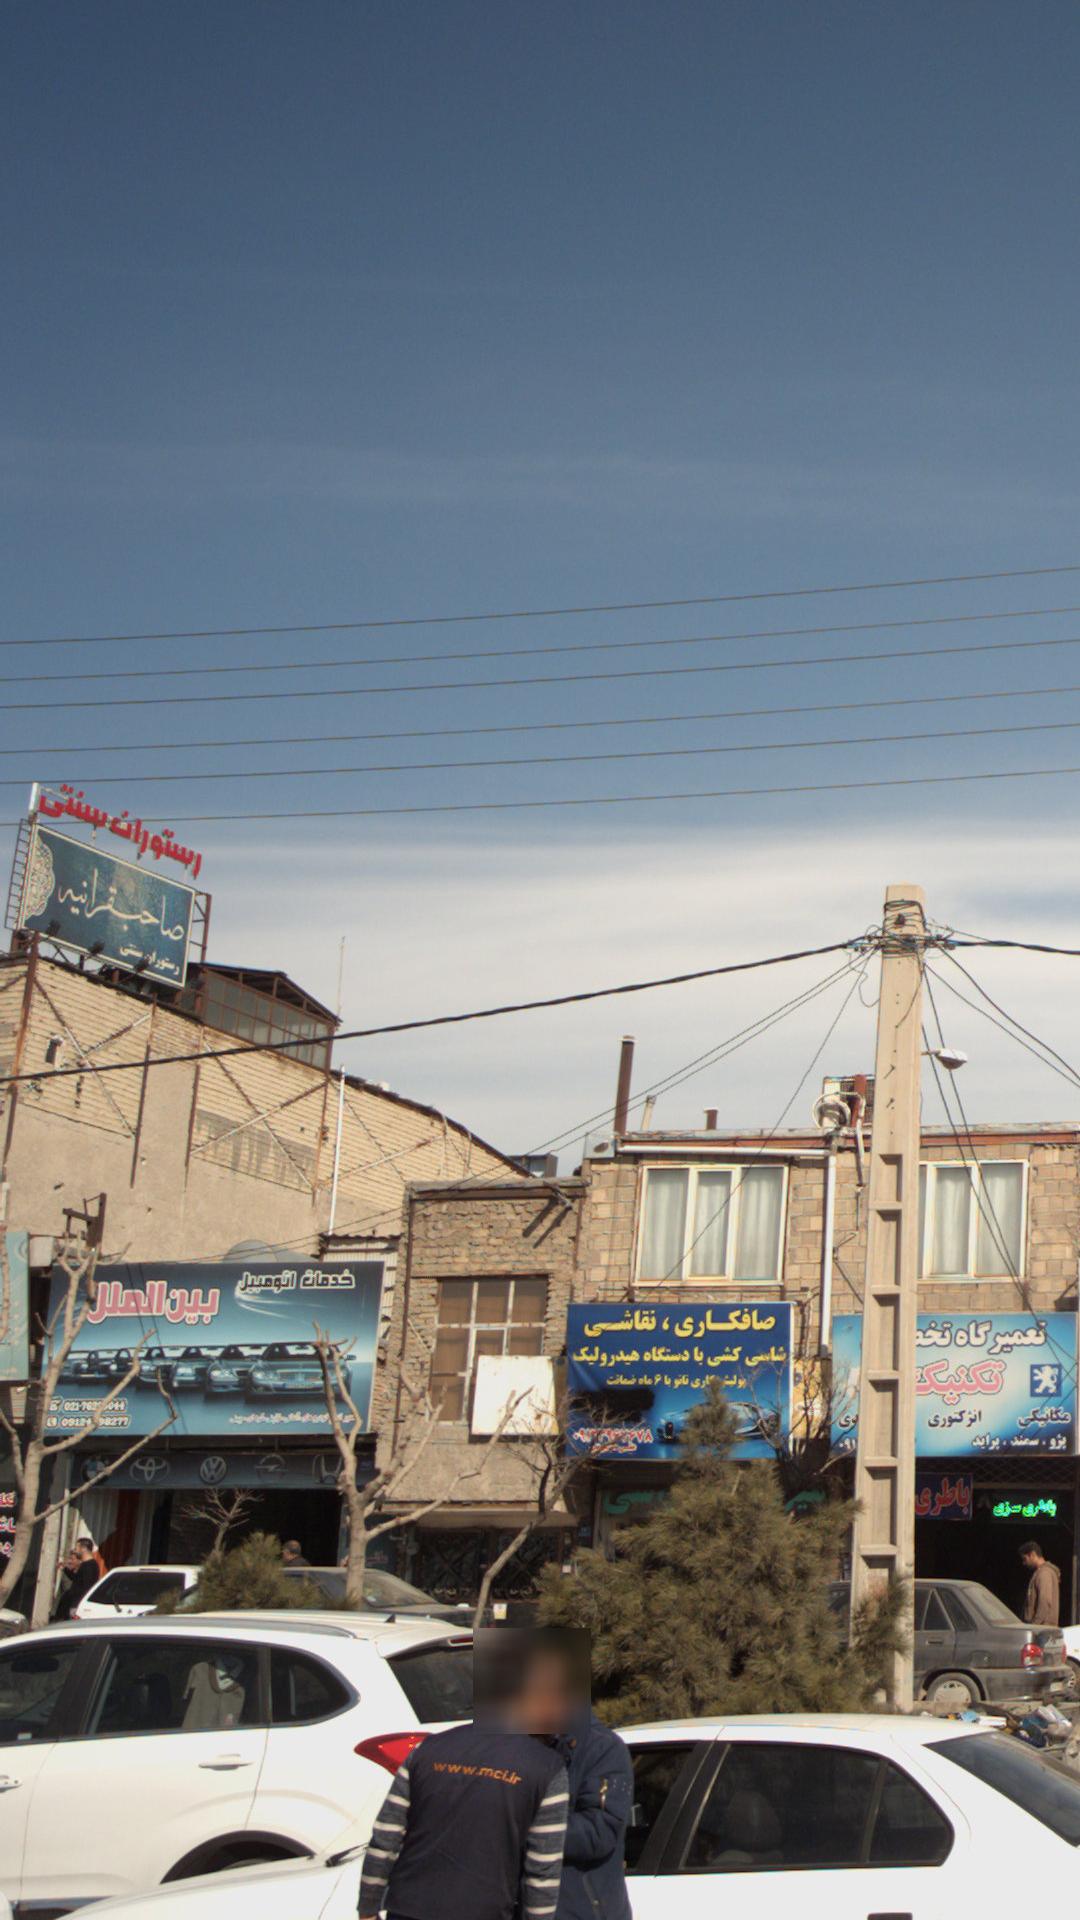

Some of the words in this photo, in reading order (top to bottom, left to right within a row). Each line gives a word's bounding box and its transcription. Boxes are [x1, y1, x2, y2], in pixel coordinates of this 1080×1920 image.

[39, 783, 108, 828] سنتی
[111, 810, 203, 879] رستوران
[239, 1271, 297, 1293] اتومبیل
[300, 1268, 355, 1289] خدمات
[584, 1309, 657, 1337] نقاشی
[674, 1308, 776, 1337] صافکاری
[573, 1346, 639, 1367] هیدرولیک
[643, 1346, 690, 1362] دستگاه
[693, 1348, 703, 1366] با
[707, 1346, 742, 1367] کشی
[745, 1347, 787, 1367] شاسی
[928, 1410, 982, 1428] انژکتوری
[1018, 1408, 1071, 1428] مکانیکی
[972, 1433, 1000, 1450] پراید
[1010, 1434, 1039, 1446] سمند
[1049, 1433, 1067, 1450] پژو
[916, 1477, 970, 1515] باطری
[433, 1762, 522, 1785] www.mci.ir
